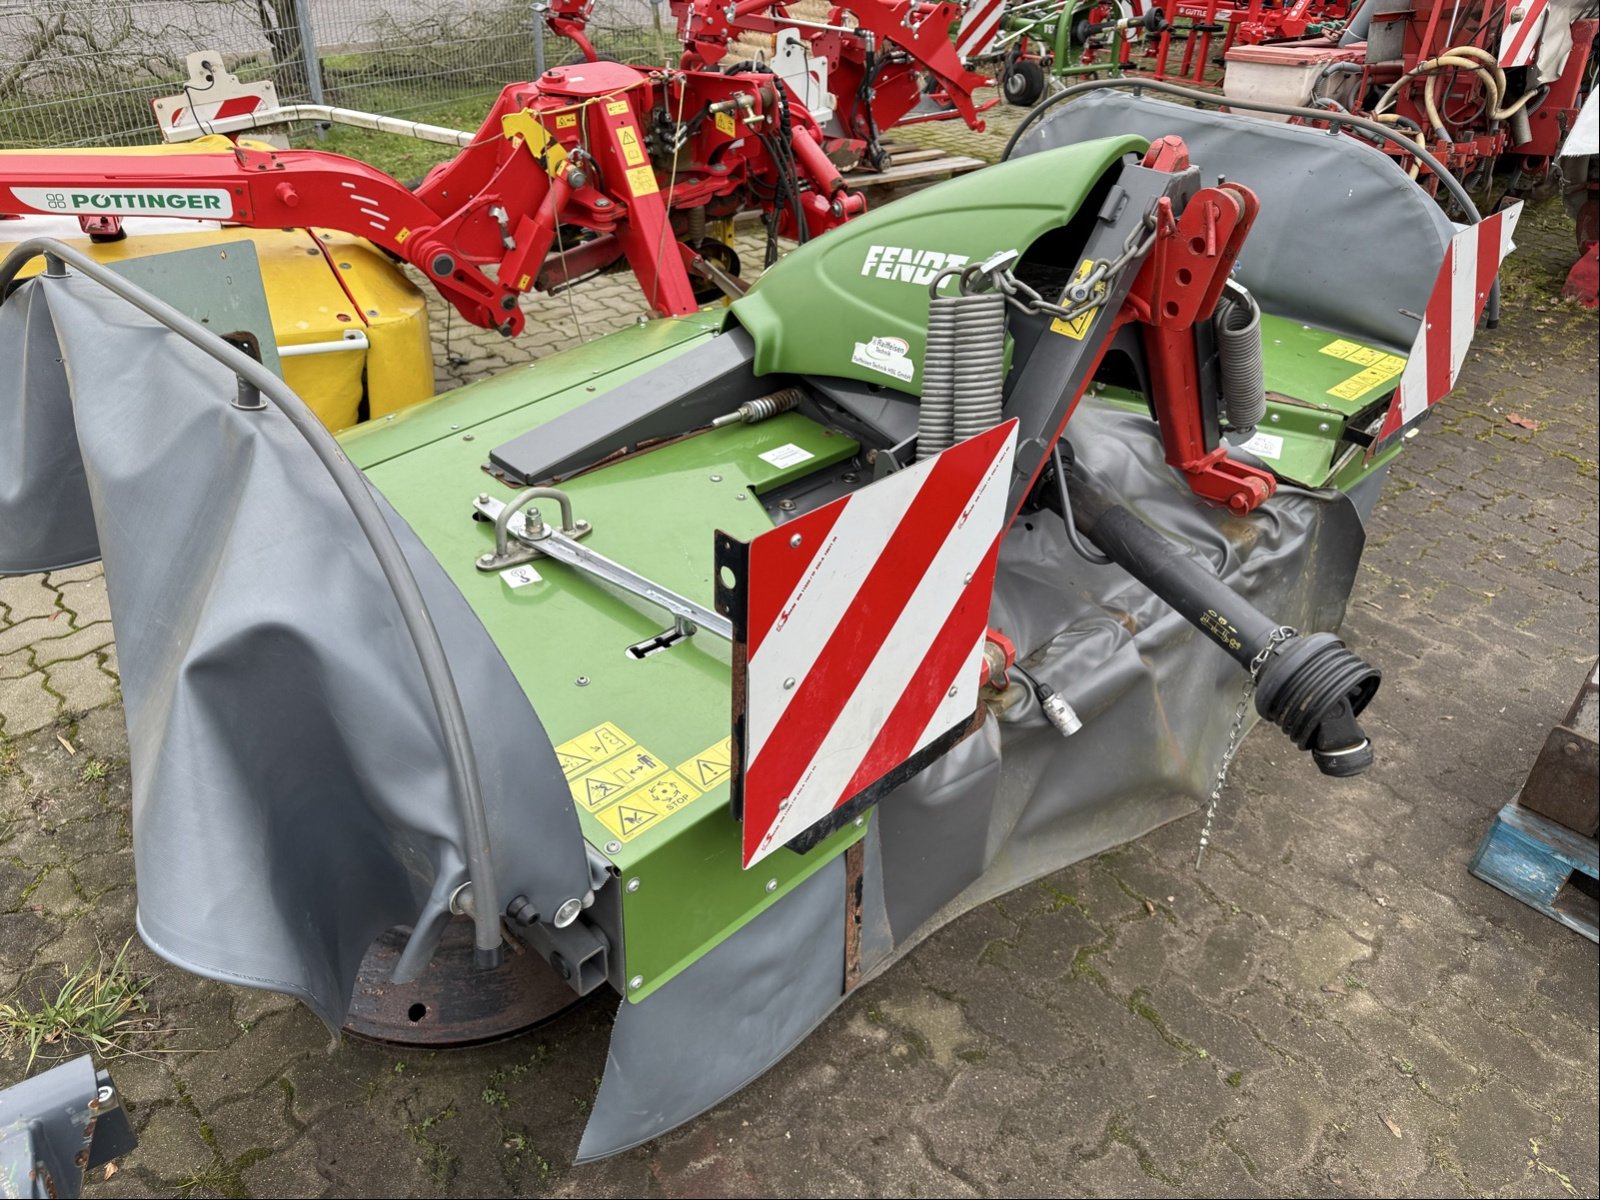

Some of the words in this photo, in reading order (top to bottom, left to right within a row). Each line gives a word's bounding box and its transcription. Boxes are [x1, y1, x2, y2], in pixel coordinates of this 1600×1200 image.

[71, 194, 221, 209] PÖTTINGER
[861, 245, 970, 288] FENDT
[876, 339, 905, 354] Raiffeisen
[666, 794, 689, 811] STOP
